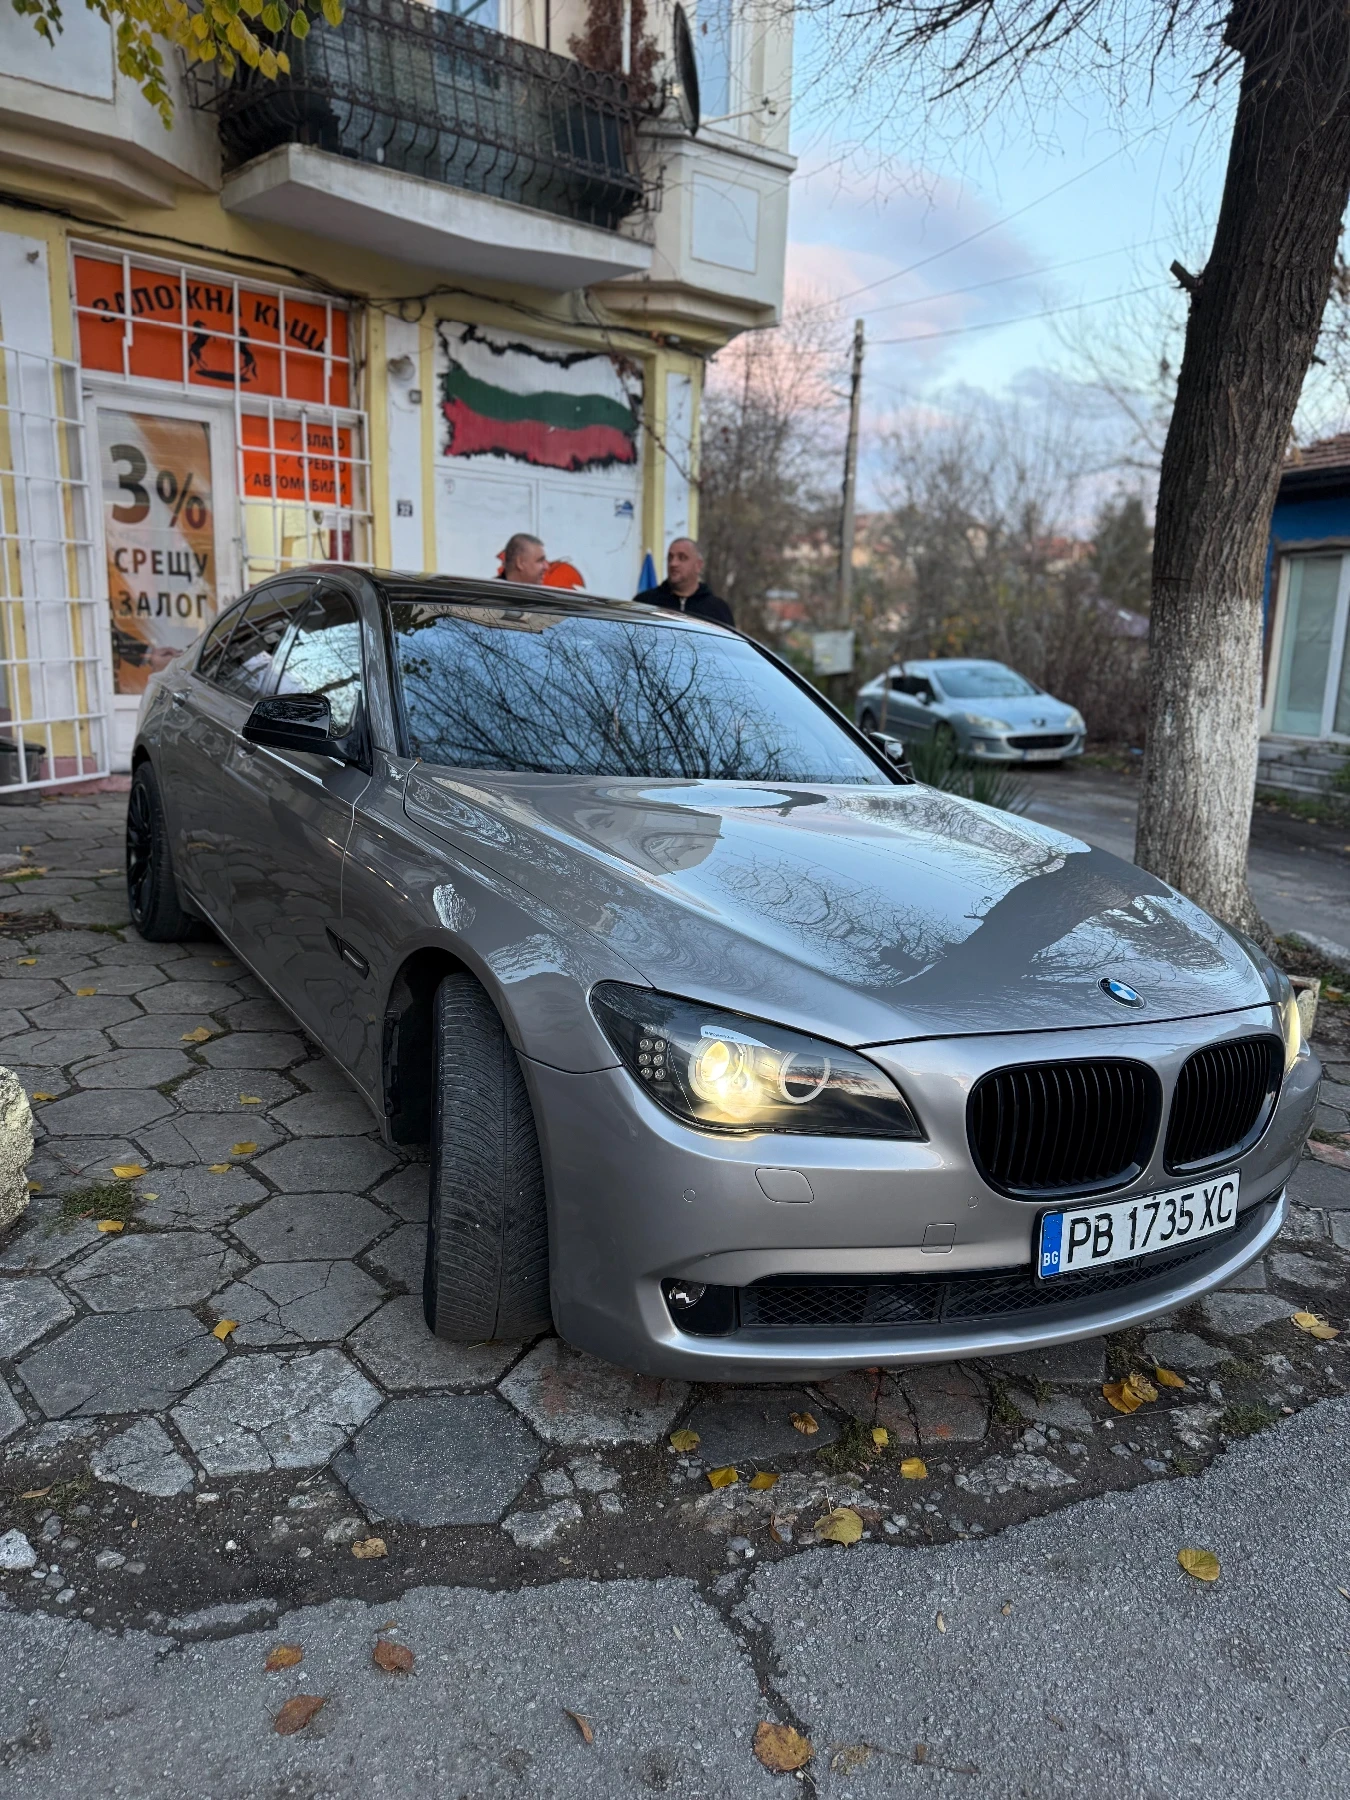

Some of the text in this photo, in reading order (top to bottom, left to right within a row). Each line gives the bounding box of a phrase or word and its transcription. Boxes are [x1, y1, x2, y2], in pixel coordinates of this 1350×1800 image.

[92, 284, 243, 323] ЗАЛОЖНА
[305, 433, 345, 450] ЗЛАТО
[110, 443, 207, 529] 3%
[253, 473, 346, 494] АВОМБИЛИ
[114, 547, 208, 582] СРЕЩУ
[118, 590, 208, 619] ЗАЛОГ
[1066, 1181, 1235, 1264] PB 1735 XC
[1042, 1250, 1059, 1267] BG
